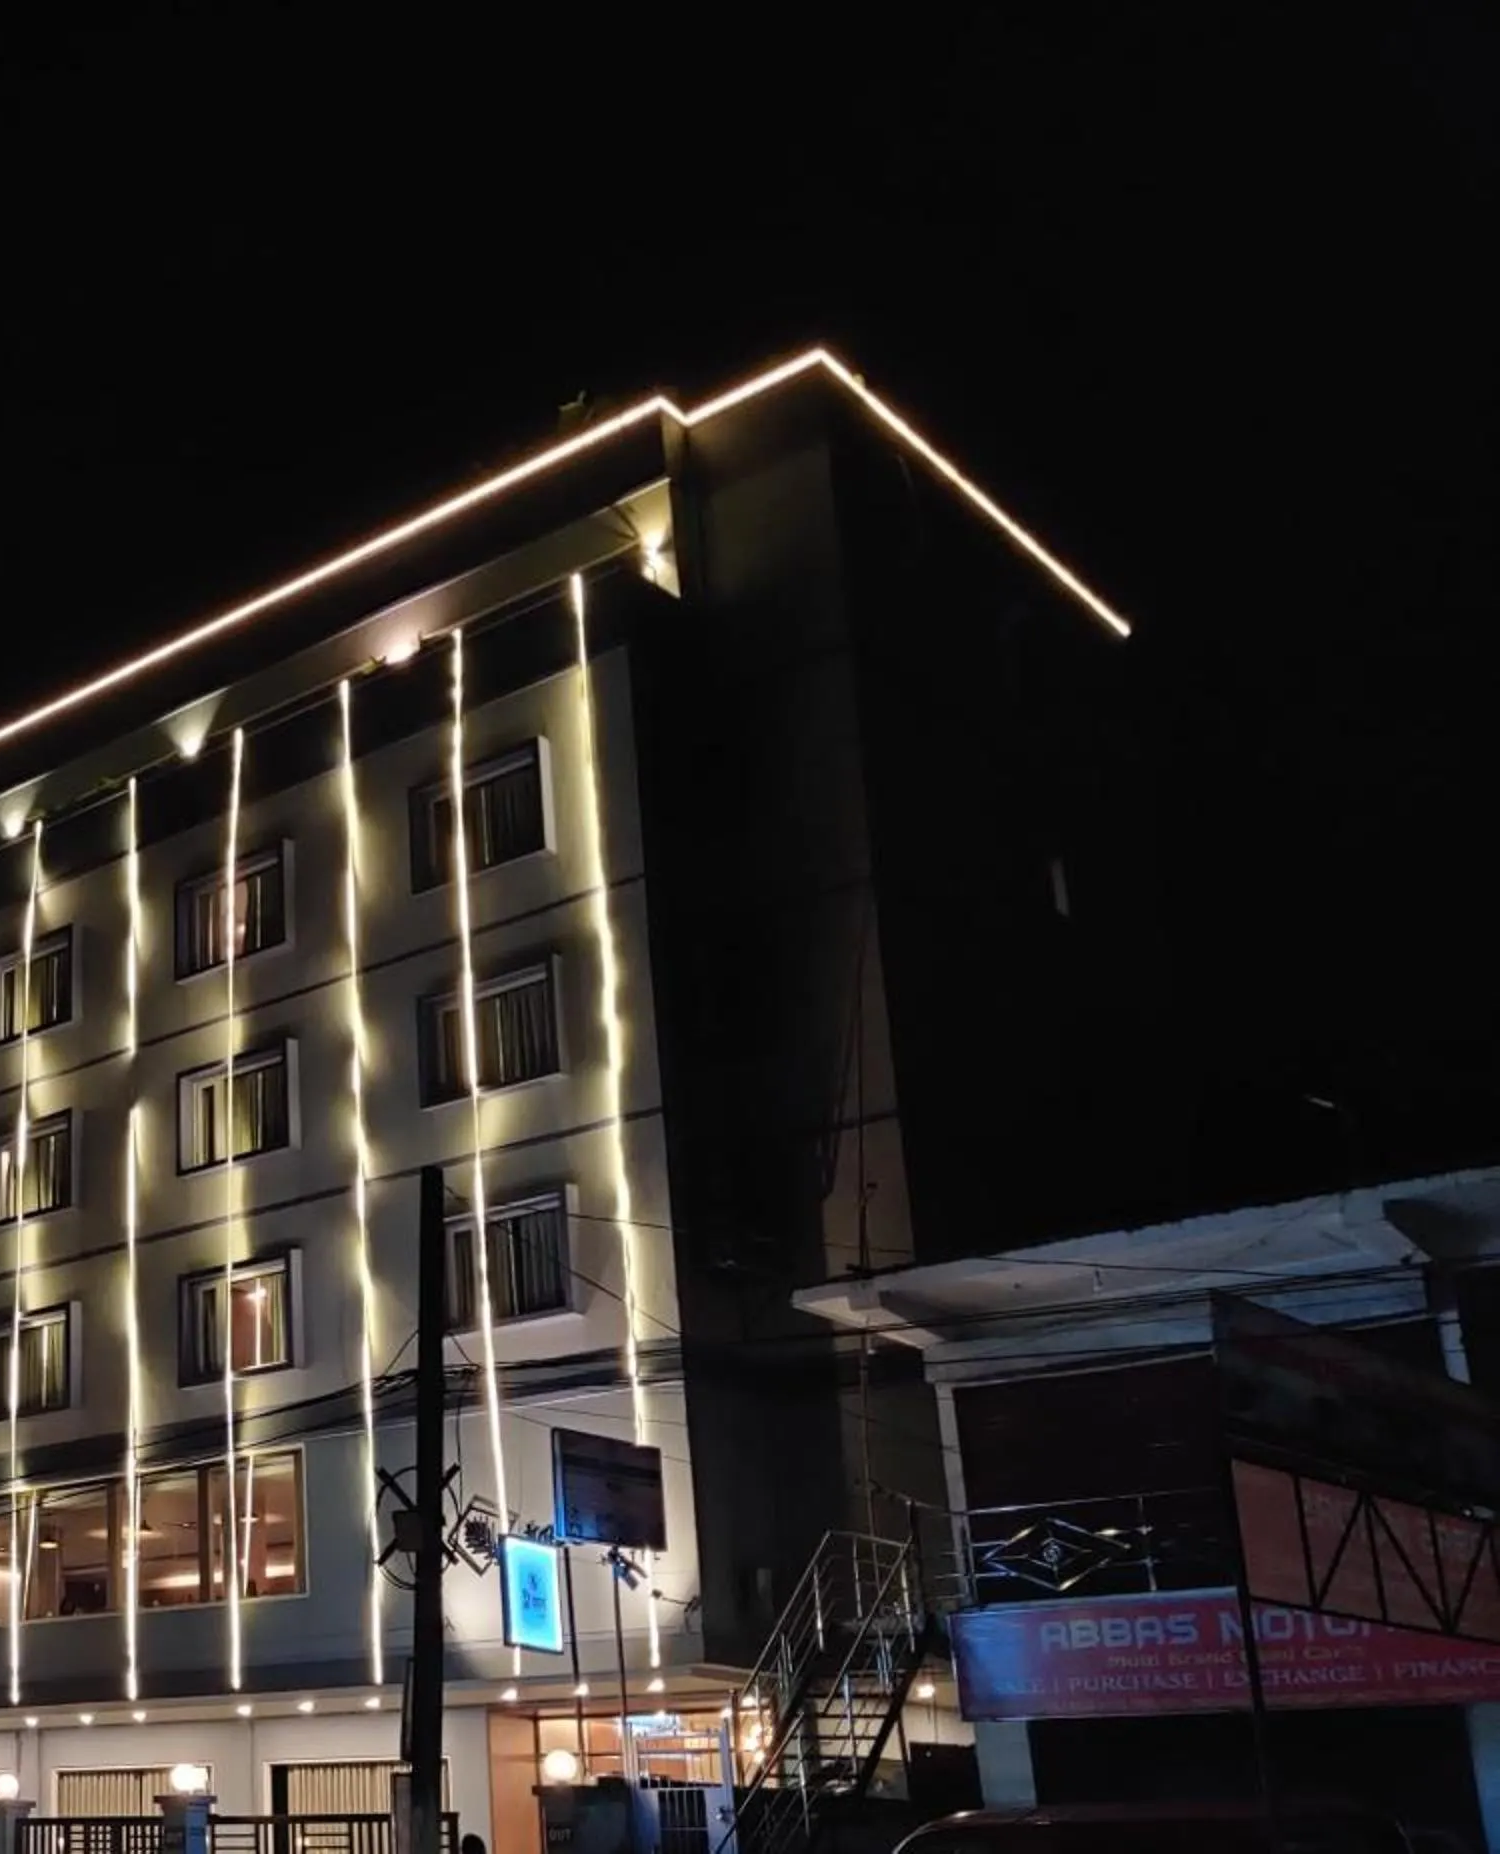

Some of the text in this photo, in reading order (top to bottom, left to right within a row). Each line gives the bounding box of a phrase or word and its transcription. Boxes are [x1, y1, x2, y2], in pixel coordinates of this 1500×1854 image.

[1040, 1607, 1372, 1652] ABBAS MOTO
[1068, 1672, 1199, 1693] PURCHASE
[1224, 1664, 1367, 1688] EXCHANGE
